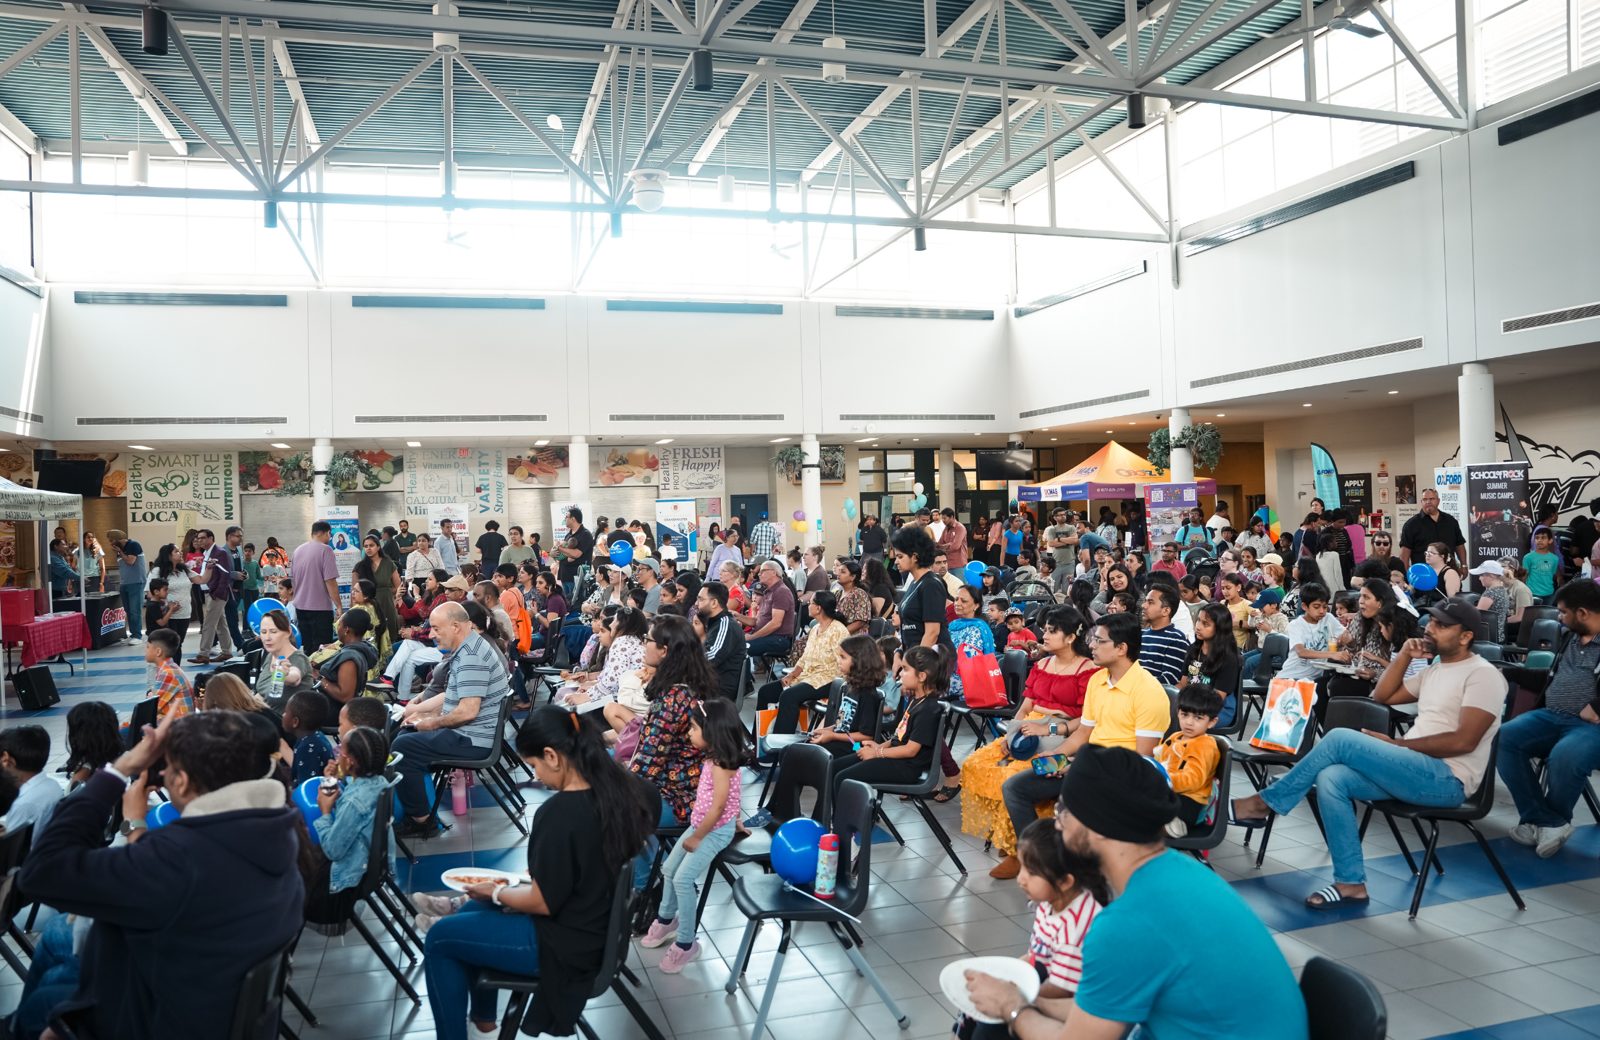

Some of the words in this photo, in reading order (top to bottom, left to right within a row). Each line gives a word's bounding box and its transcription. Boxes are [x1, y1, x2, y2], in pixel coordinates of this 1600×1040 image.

[672, 447, 722, 459] FRESH
[147, 454, 200, 468] SMART
[681, 459, 721, 472] Happy!
[406, 450, 417, 494] Healthy
[661, 448, 671, 491] Healthy
[1470, 470, 1498, 480] SCHOOL
[1502, 469, 1525, 479] ROCK
[129, 455, 145, 510] Healthy
[204, 453, 220, 500] FIBRE
[479, 451, 490, 513] VARIETY
[192, 470, 202, 500] grow
[223, 453, 233, 520] NUTRITIOUS
[1486, 482, 1508, 490] SUMMER
[494, 481, 504, 513] Strong
[1345, 489, 1365, 497] HERE
[1480, 492, 1497, 500] MUSIC
[1497, 491, 1514, 499] CAMPS
[145, 501, 183, 510] GREEN
[405, 495, 457, 505] CALCIUM
[130, 510, 179, 523] LOCA
[406, 506, 429, 515] Min
[1478, 546, 1499, 556] START
[1500, 547, 1519, 557] YOUR
